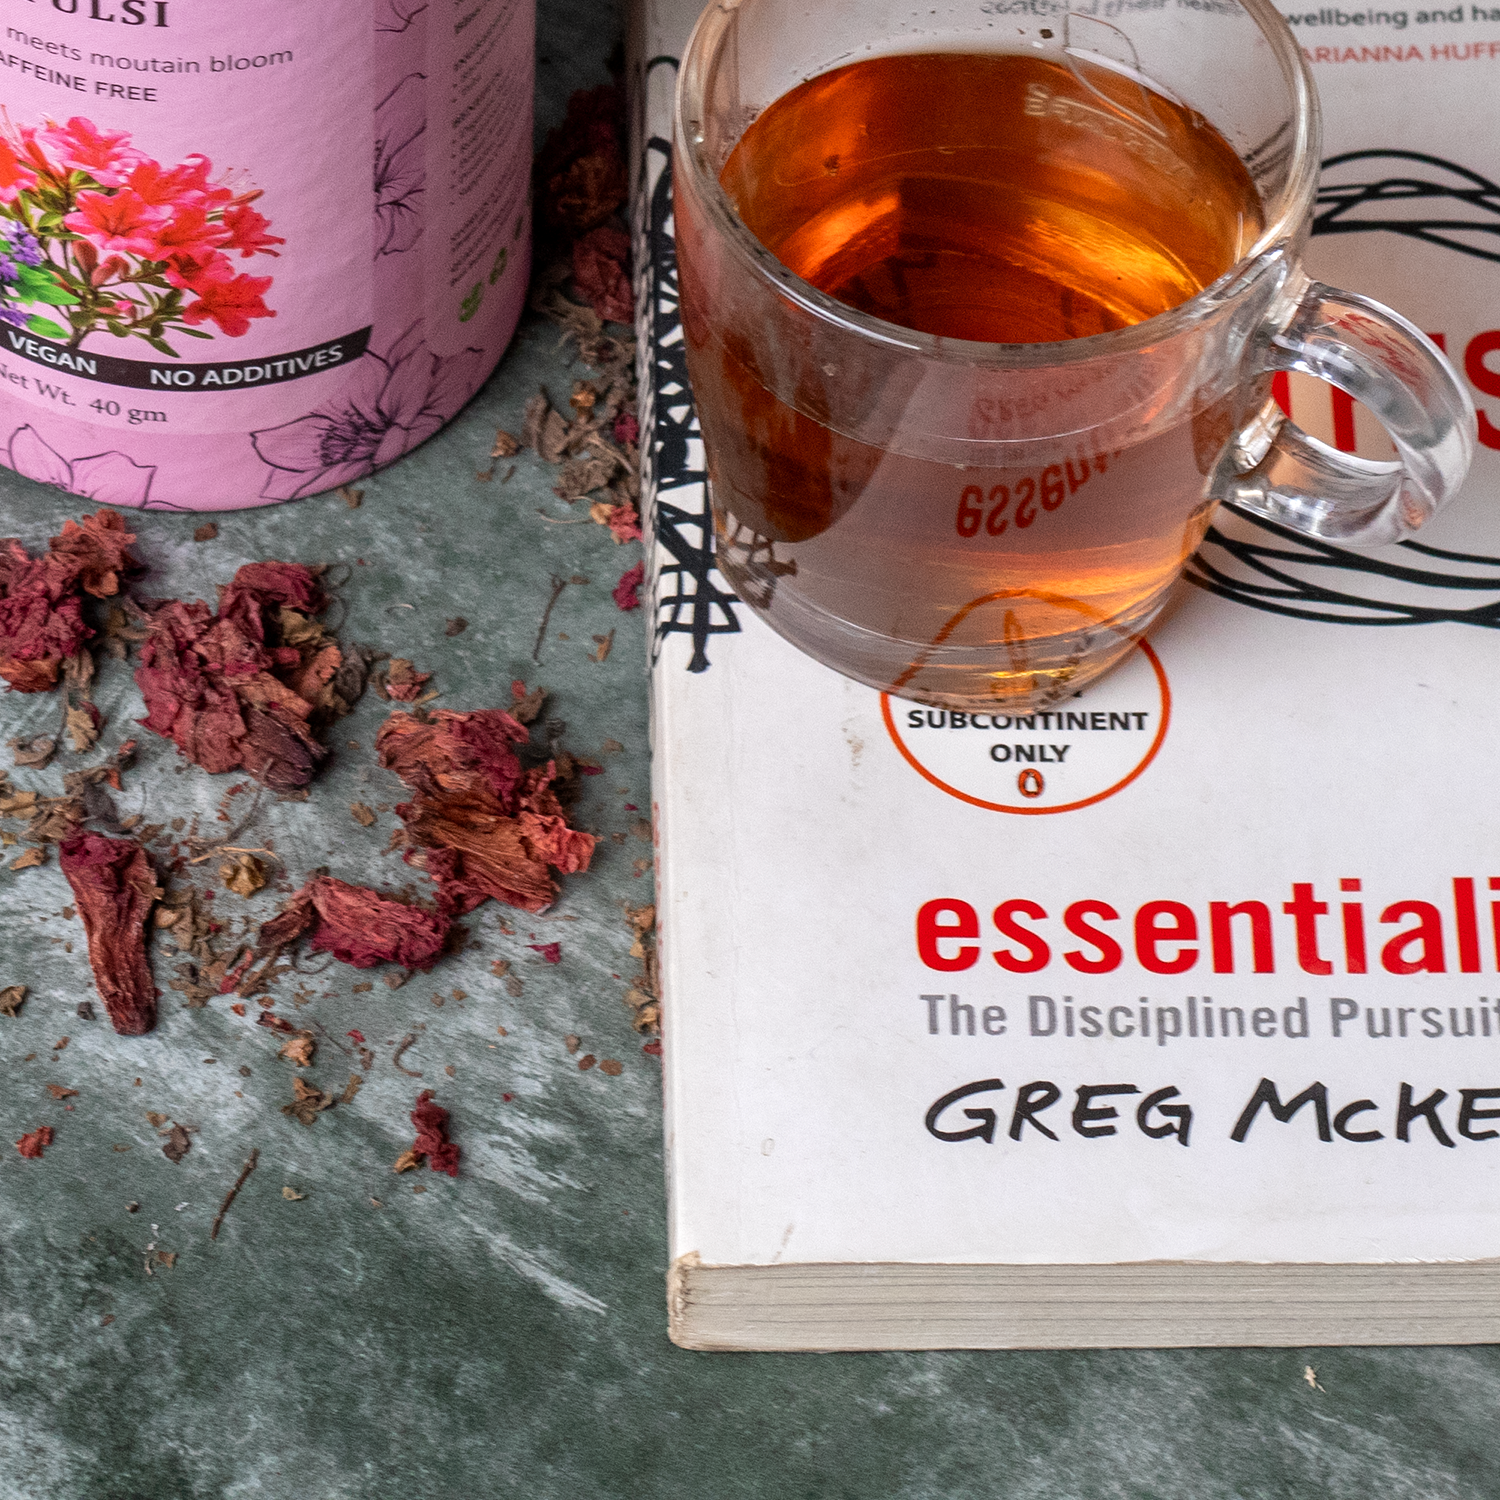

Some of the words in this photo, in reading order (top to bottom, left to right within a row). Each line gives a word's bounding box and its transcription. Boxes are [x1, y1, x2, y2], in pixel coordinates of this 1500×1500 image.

[1416, 2, 1464, 24] and
[6, 26, 83, 62] meets
[89, 51, 201, 74] moutain
[209, 49, 294, 73] bloom
[94, 80, 158, 102] FREE
[7, 330, 98, 375] VEGAN
[150, 368, 196, 386] NO
[200, 344, 344, 386] ADDITIVES
[33, 377, 77, 407] Wt.
[89, 397, 121, 416] 40
[127, 408, 169, 425] gm
[908, 709, 1149, 731] SUBCONTINENT
[990, 743, 1071, 763] ONLY
[919, 993, 1007, 1036] The
[1028, 994, 1310, 1046] Disciplined
[924, 1077, 1193, 1147] GREG
